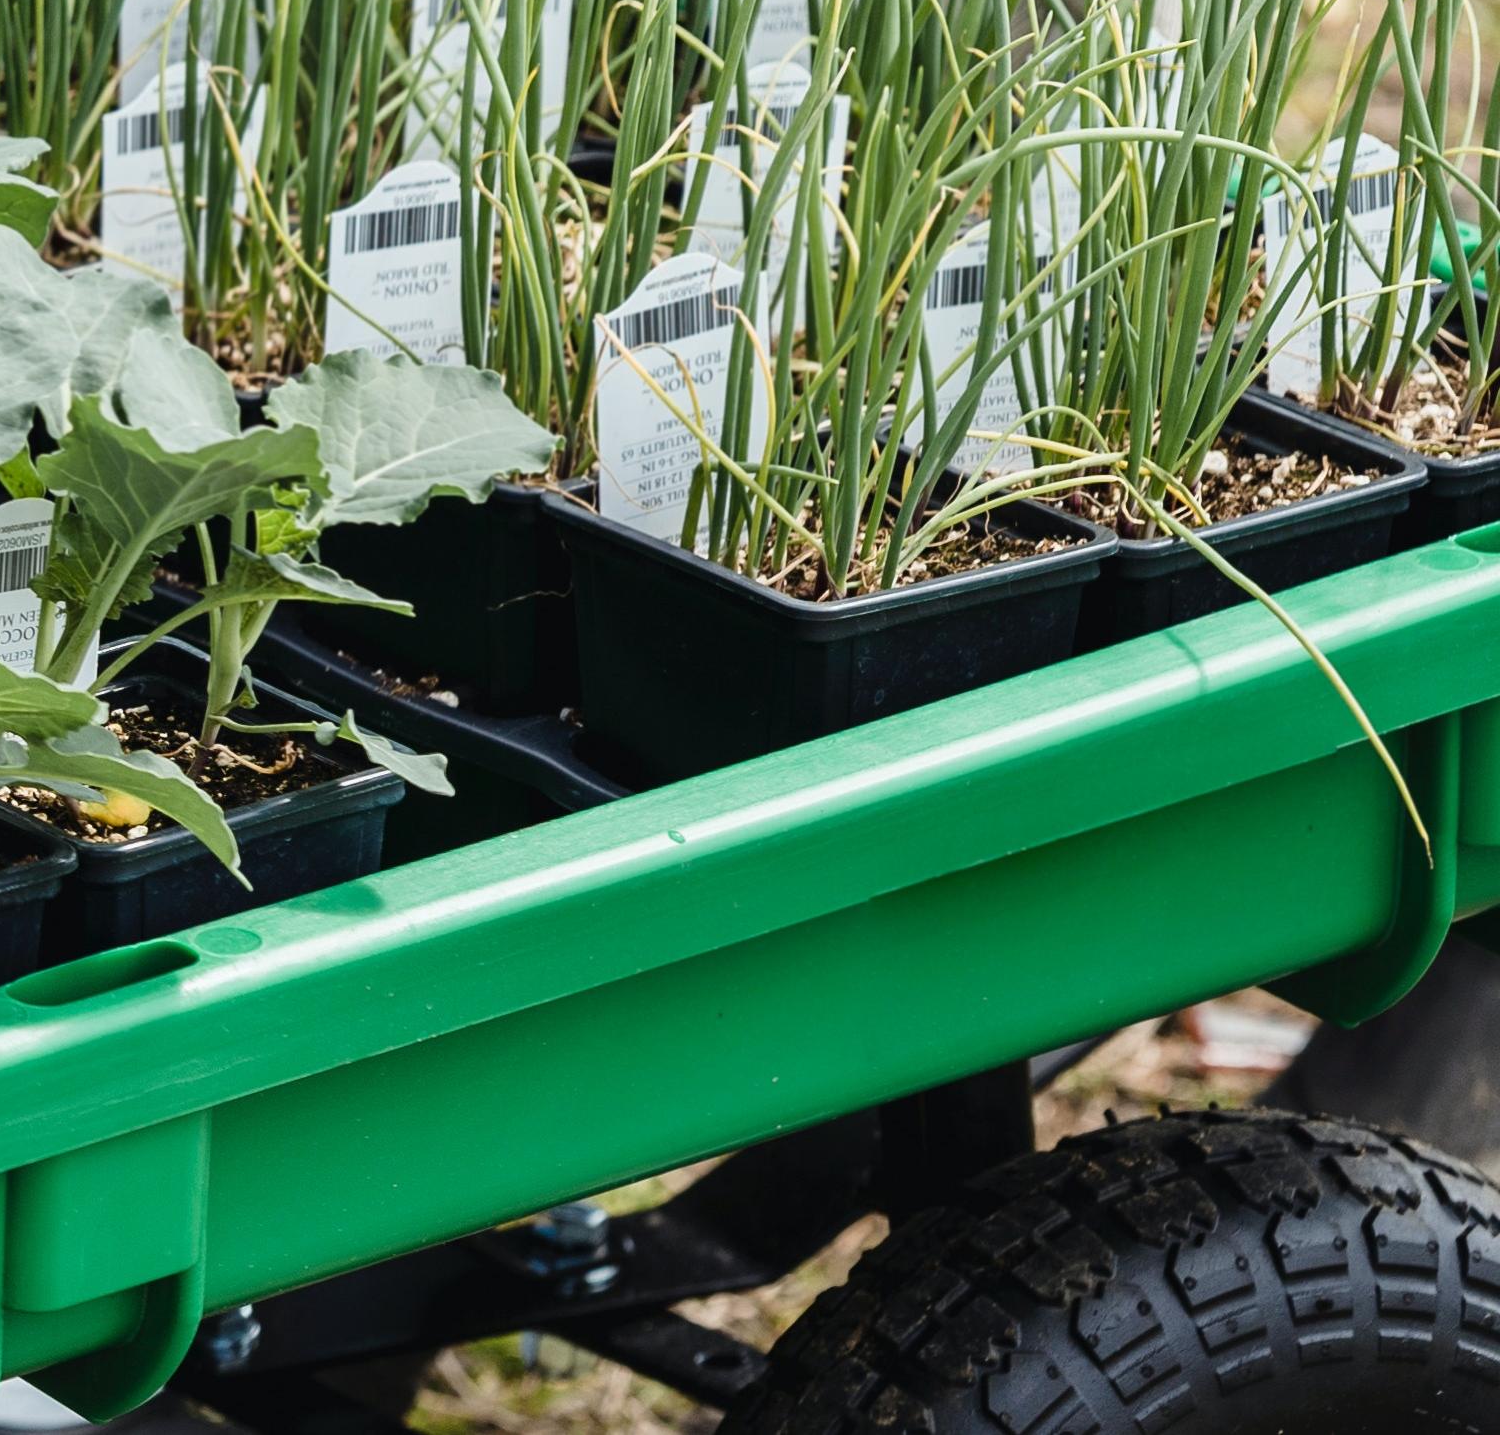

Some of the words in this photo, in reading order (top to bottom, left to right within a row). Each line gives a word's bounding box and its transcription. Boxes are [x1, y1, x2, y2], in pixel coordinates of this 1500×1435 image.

[384, 279, 439, 298] ONION
[621, 449, 634, 462] 65
[666, 488, 685, 500] ULL
